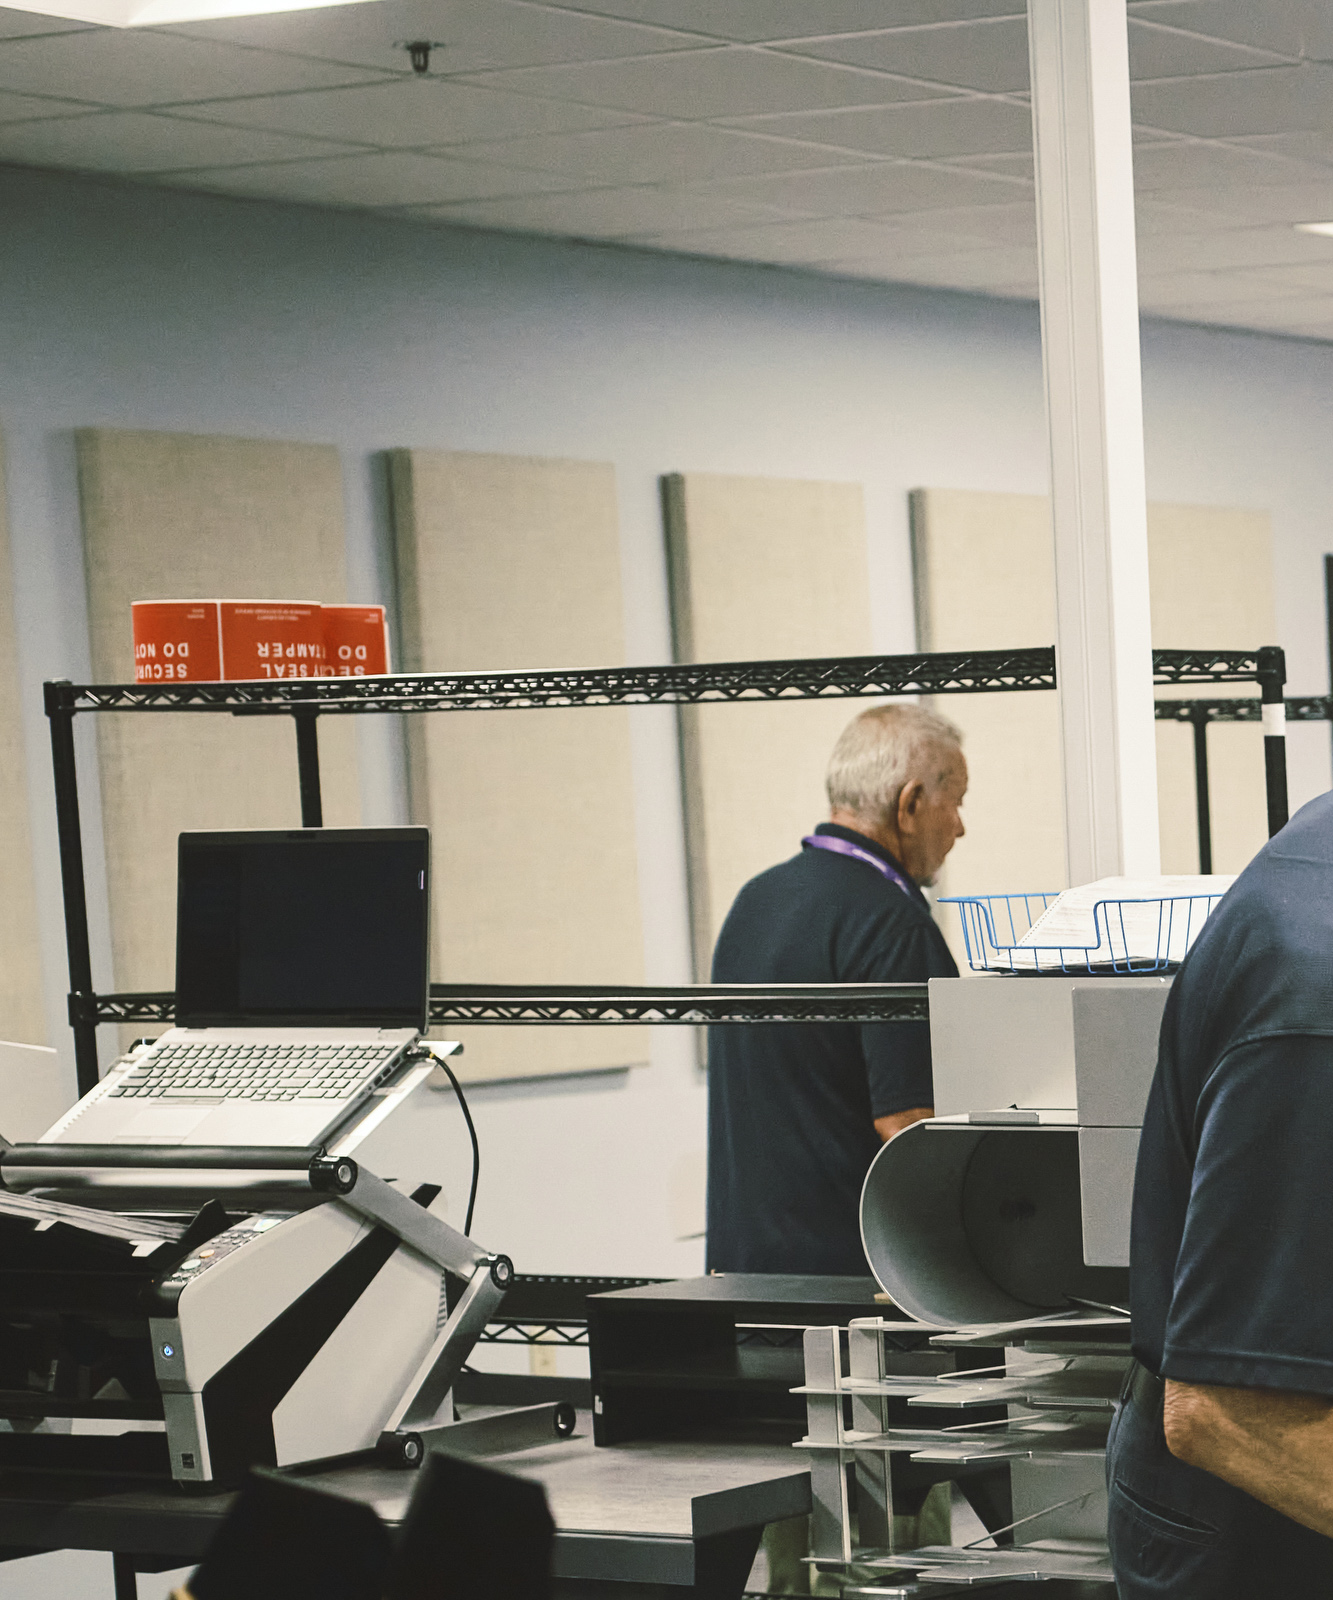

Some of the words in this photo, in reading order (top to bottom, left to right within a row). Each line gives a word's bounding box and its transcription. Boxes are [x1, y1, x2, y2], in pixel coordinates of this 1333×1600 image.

[163, 642, 189, 658] DO
[257, 642, 321, 659] TAMPER
[338, 645, 367, 660] DO
[260, 663, 308, 677] SEAL
